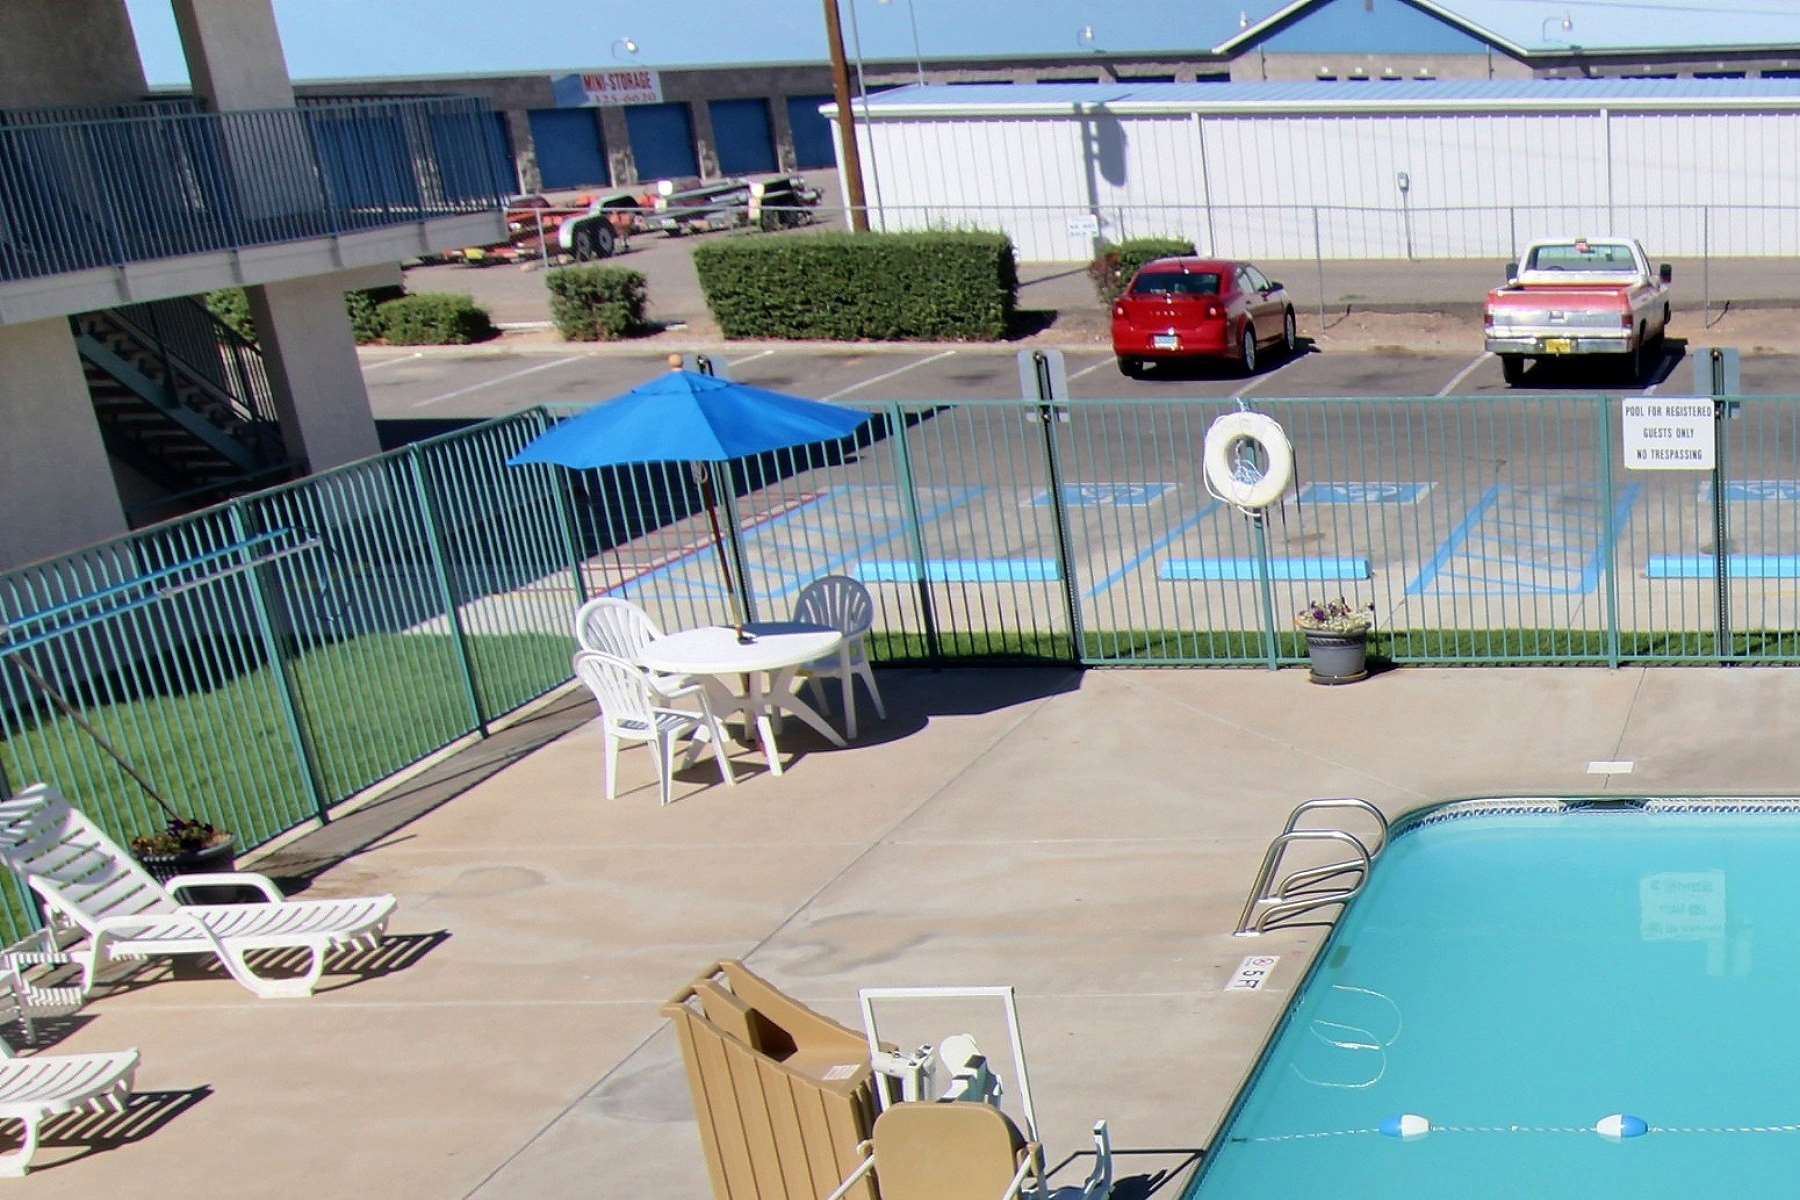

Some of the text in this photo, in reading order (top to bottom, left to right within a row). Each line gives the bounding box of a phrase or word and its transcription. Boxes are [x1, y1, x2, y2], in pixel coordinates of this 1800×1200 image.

[583, 71, 652, 91] MINI-STORAGE
[1625, 405, 1713, 417] POOL FOR REGISTERED
[1642, 427, 1694, 439] GUESTS ONLY
[1636, 448, 1703, 461] NO TRESPASSING
[1232, 969, 1265, 989] 5 FT
